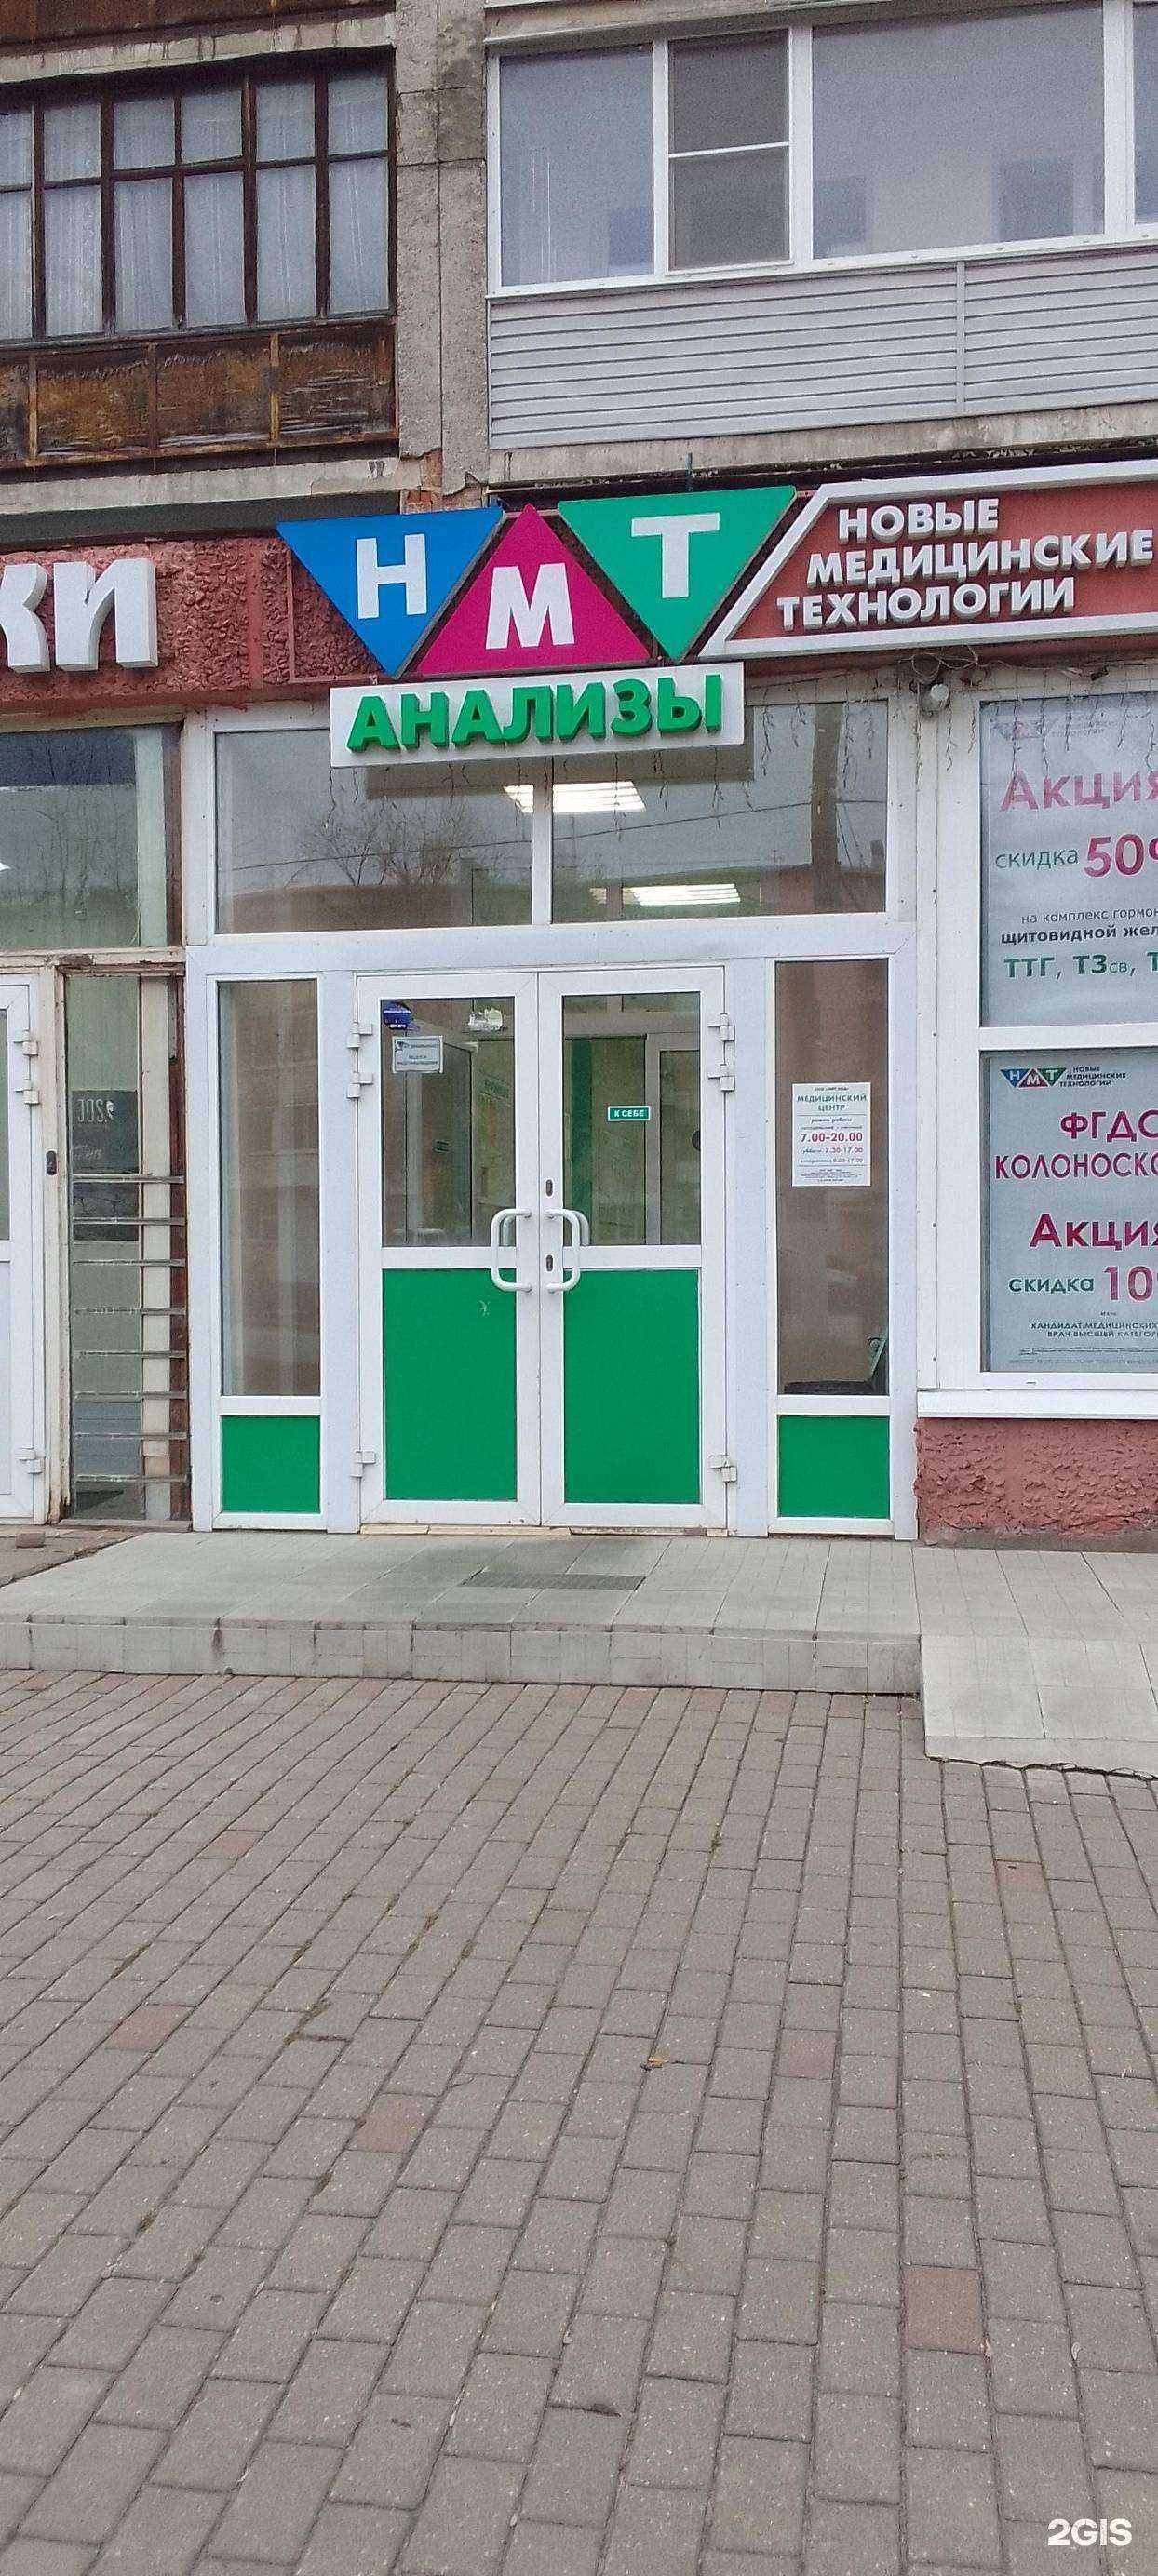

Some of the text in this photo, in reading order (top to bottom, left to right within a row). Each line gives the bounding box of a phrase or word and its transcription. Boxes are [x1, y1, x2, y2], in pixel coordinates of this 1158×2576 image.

[838, 498, 1000, 544] НОВЫЕ
[806, 530, 1154, 588] МЕДИЦИНСКИЕ
[356, 513, 720, 650] НМТ
[776, 576, 1075, 631] ТЕХНОЛОГИИ
[346, 673, 722, 754] АНАЛИЗЫ
[995, 833, 1158, 878] скидка 50
[1021, 914, 1038, 924] на
[1043, 909, 1109, 923] комплекс
[1001, 924, 1117, 946] щитовидной
[1059, 1080, 1112, 1088] ТЕХНОЛОГИИ
[1066, 1072, 1126, 1080] МЕДИЦИНСКИЕ
[797, 1093, 867, 1103] МЕДИЦИНСКИЙ
[818, 1104, 846, 1112] ЦЕНТР
[614, 1109, 620, 1118] К
[801, 1133, 863, 1143] 7.00-20.00
[1030, 1213, 1158, 1252] Акци
[1008, 1265, 1158, 1302] скидка 10
